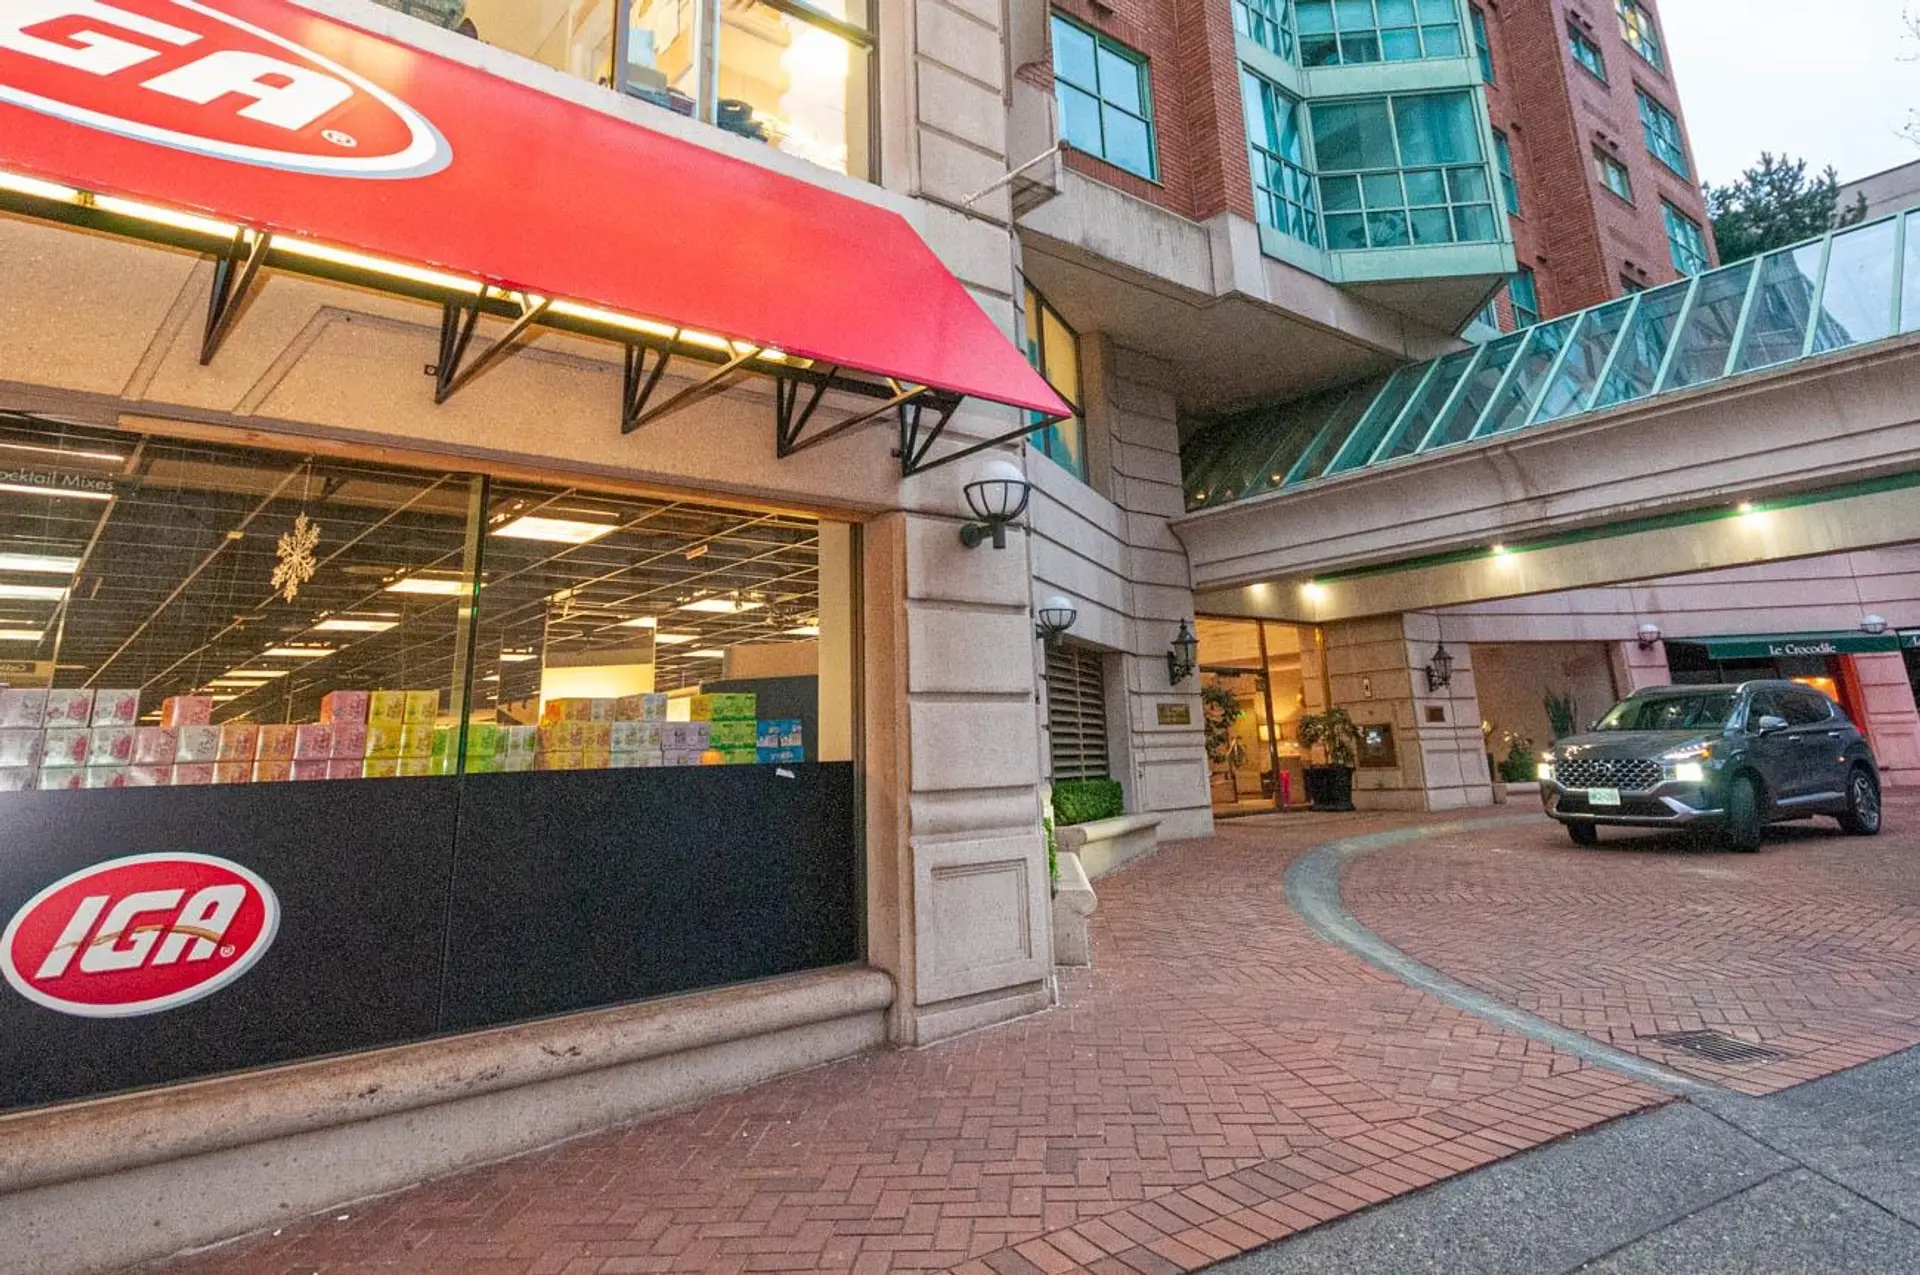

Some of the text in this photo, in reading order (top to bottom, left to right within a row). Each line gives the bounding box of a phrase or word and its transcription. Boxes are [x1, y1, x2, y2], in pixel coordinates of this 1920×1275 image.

[62, 474, 114, 491] Mixes
[1785, 642, 1837, 655] Crocodile
[34, 883, 247, 980] IGA
